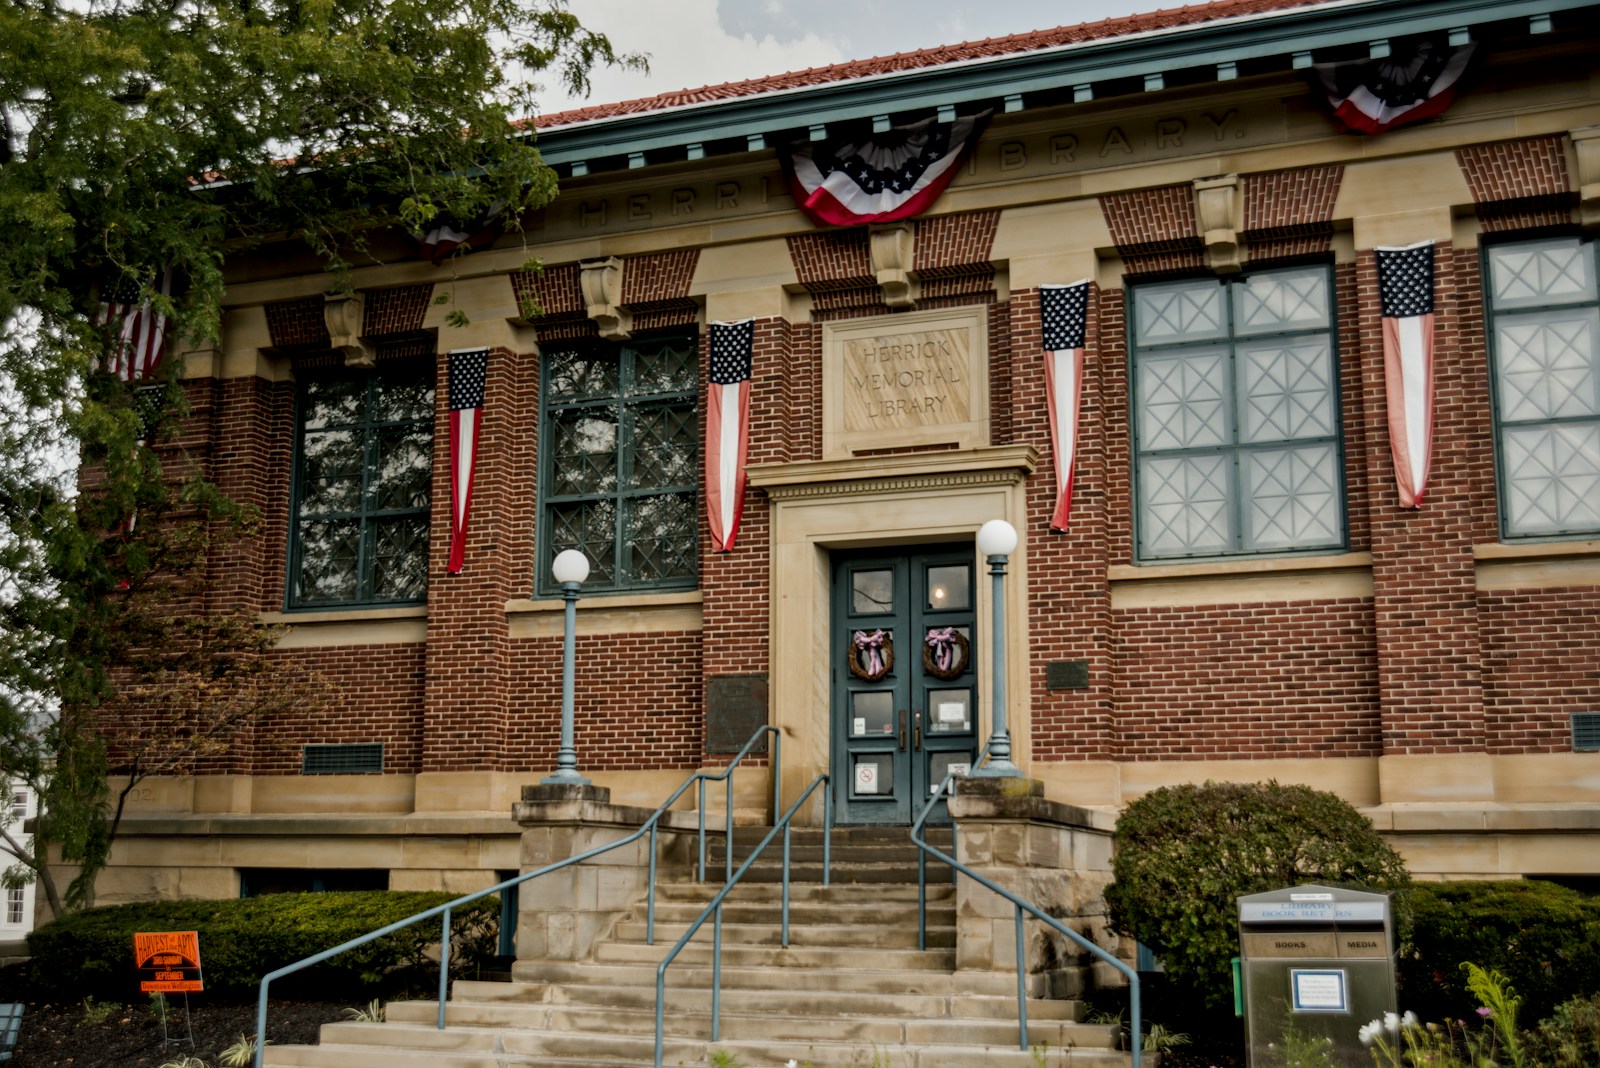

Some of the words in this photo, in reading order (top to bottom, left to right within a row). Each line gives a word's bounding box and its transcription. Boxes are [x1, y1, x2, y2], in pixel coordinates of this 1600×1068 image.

[580, 176, 769, 228] HERRI
[967, 108, 1246, 175] IBRARY.
[863, 340, 950, 364] HERRICK
[854, 367, 960, 392] MEMORIAL
[867, 395, 947, 418] LIBRARY
[136, 934, 169, 964] HARVEST
[178, 934, 198, 963] ARTS
[164, 956, 183, 965] SUNDAY
[155, 971, 184, 980] SEPTEMBER
[171, 982, 201, 990] Wellington
